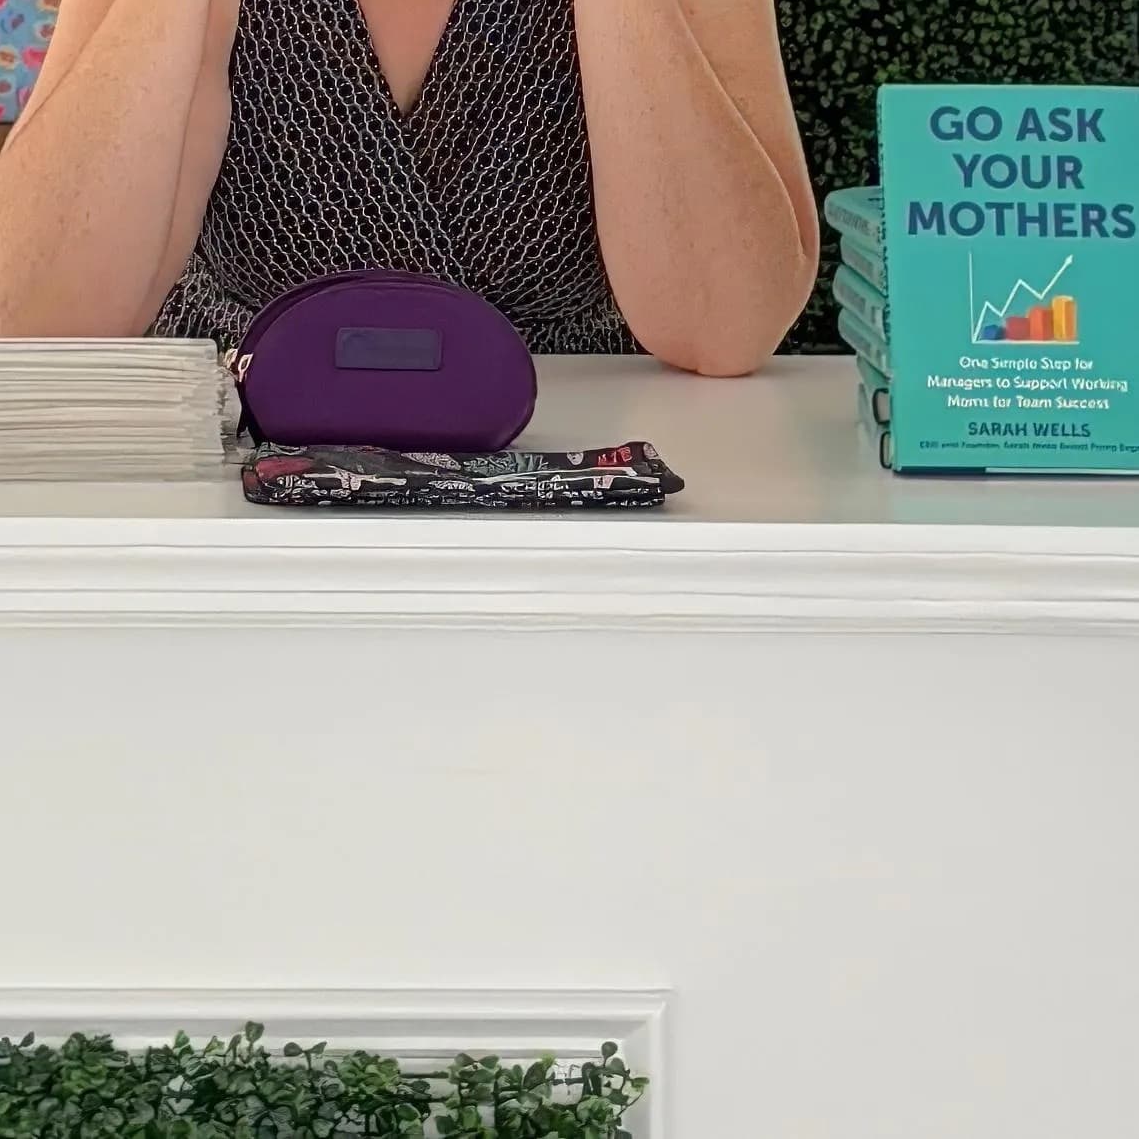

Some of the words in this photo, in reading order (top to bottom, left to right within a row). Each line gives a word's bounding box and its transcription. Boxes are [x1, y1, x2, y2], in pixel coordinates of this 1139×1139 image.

[929, 105, 1003, 142] GO
[1015, 107, 1106, 142] ASK
[953, 154, 1085, 189] YOUR
[907, 200, 1137, 238] MOTHERS
[959, 356, 989, 370] One
[990, 356, 1038, 371] Simple
[1040, 356, 1071, 371] Step
[1074, 357, 1094, 370] for
[927, 375, 992, 391] Managers
[996, 377, 1011, 388] to
[1013, 376, 1068, 391] Support
[1072, 378, 1129, 392] Working
[947, 395, 989, 408] Moms
[993, 395, 1011, 408] for
[1016, 395, 1052, 408] Team
[1055, 396, 1110, 410] Success
[968, 421, 1028, 437] SARAH
[1033, 422, 1091, 438] WELLS
